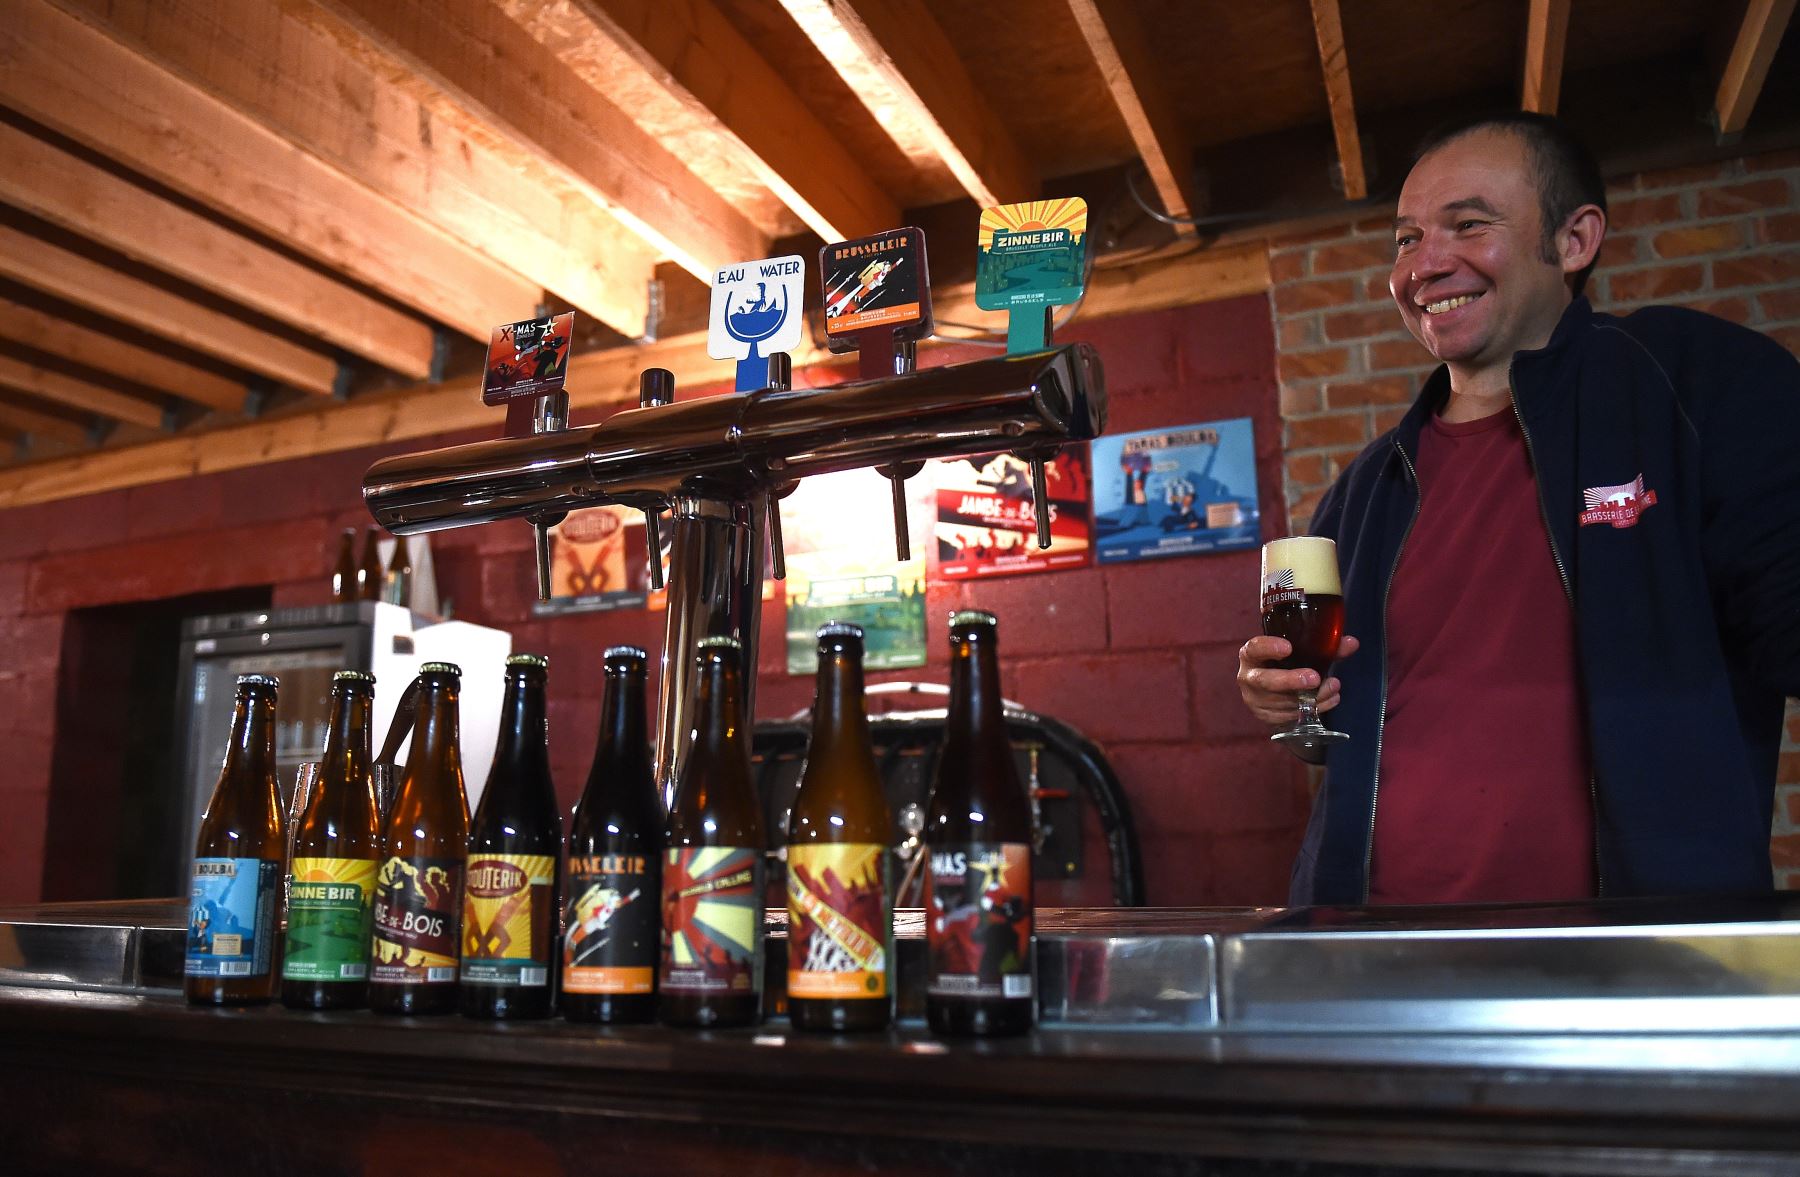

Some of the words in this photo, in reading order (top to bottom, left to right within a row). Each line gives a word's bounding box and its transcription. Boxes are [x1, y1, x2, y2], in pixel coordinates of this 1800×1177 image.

[997, 233, 1041, 247] ZINNE
[1042, 231, 1064, 243] BIR
[835, 236, 908, 260] BRUSSELEIR
[718, 268, 745, 284] EAU
[759, 261, 800, 277] WATER
[500, 322, 536, 342] X-MAS
[1581, 510, 1623, 523] BRASSERIE
[1626, 508, 1634, 518] DE
[1280, 590, 1300, 602] SENNE
[198, 863, 233, 875] BOULBA
[328, 888, 355, 900] BIR
